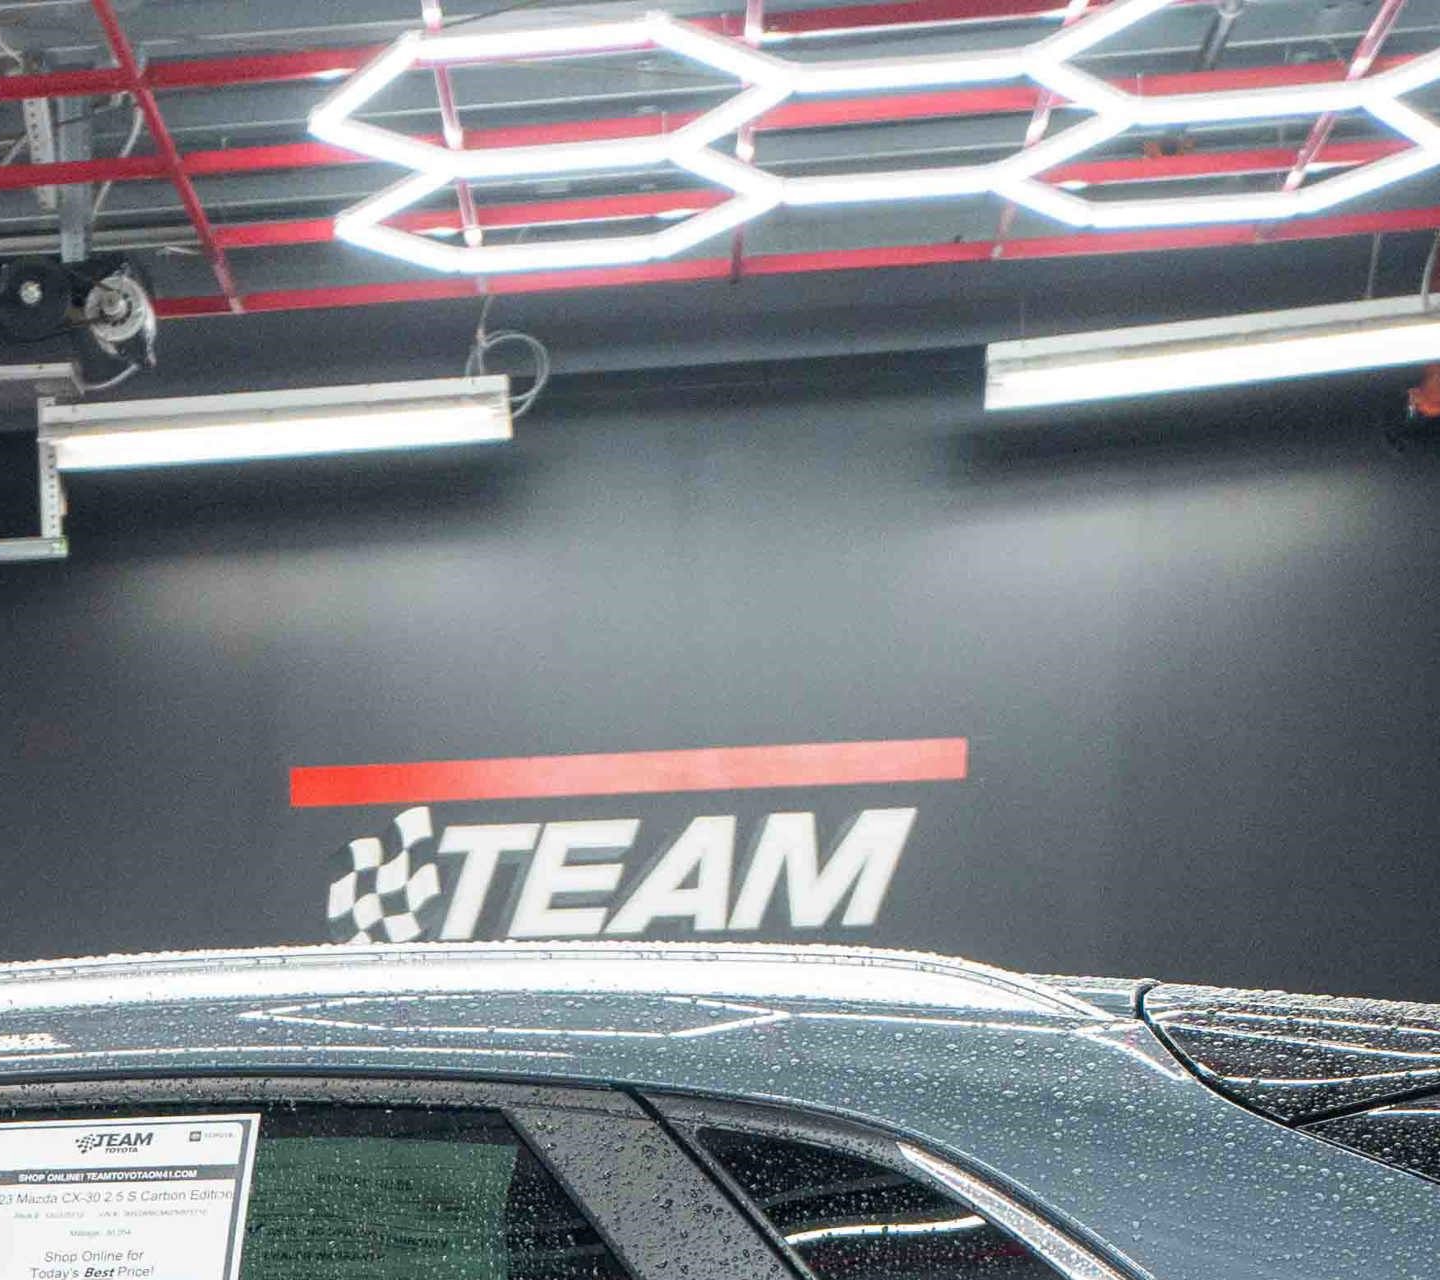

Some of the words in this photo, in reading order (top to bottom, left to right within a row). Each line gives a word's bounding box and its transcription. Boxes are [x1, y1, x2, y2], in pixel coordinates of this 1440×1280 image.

[436, 806, 918, 940] TEAM
[94, 1132, 154, 1147] TEAM
[18, 1173, 45, 1182] SHOP
[47, 1172, 85, 1182] ONLINE!
[16, 1193, 58, 1204] Mazda
[62, 1192, 101, 1203] CX-30
[127, 1191, 137, 1202] S
[140, 1190, 187, 1201] Carbon
[190, 1188, 233, 1201] Edition
[44, 1251, 77, 1263] Shop
[81, 1250, 123, 1262] Online
[127, 1249, 145, 1261] for
[30, 1267, 80, 1280] Today's
[84, 1267, 115, 1279] Best
[118, 1265, 154, 1278] Price!
